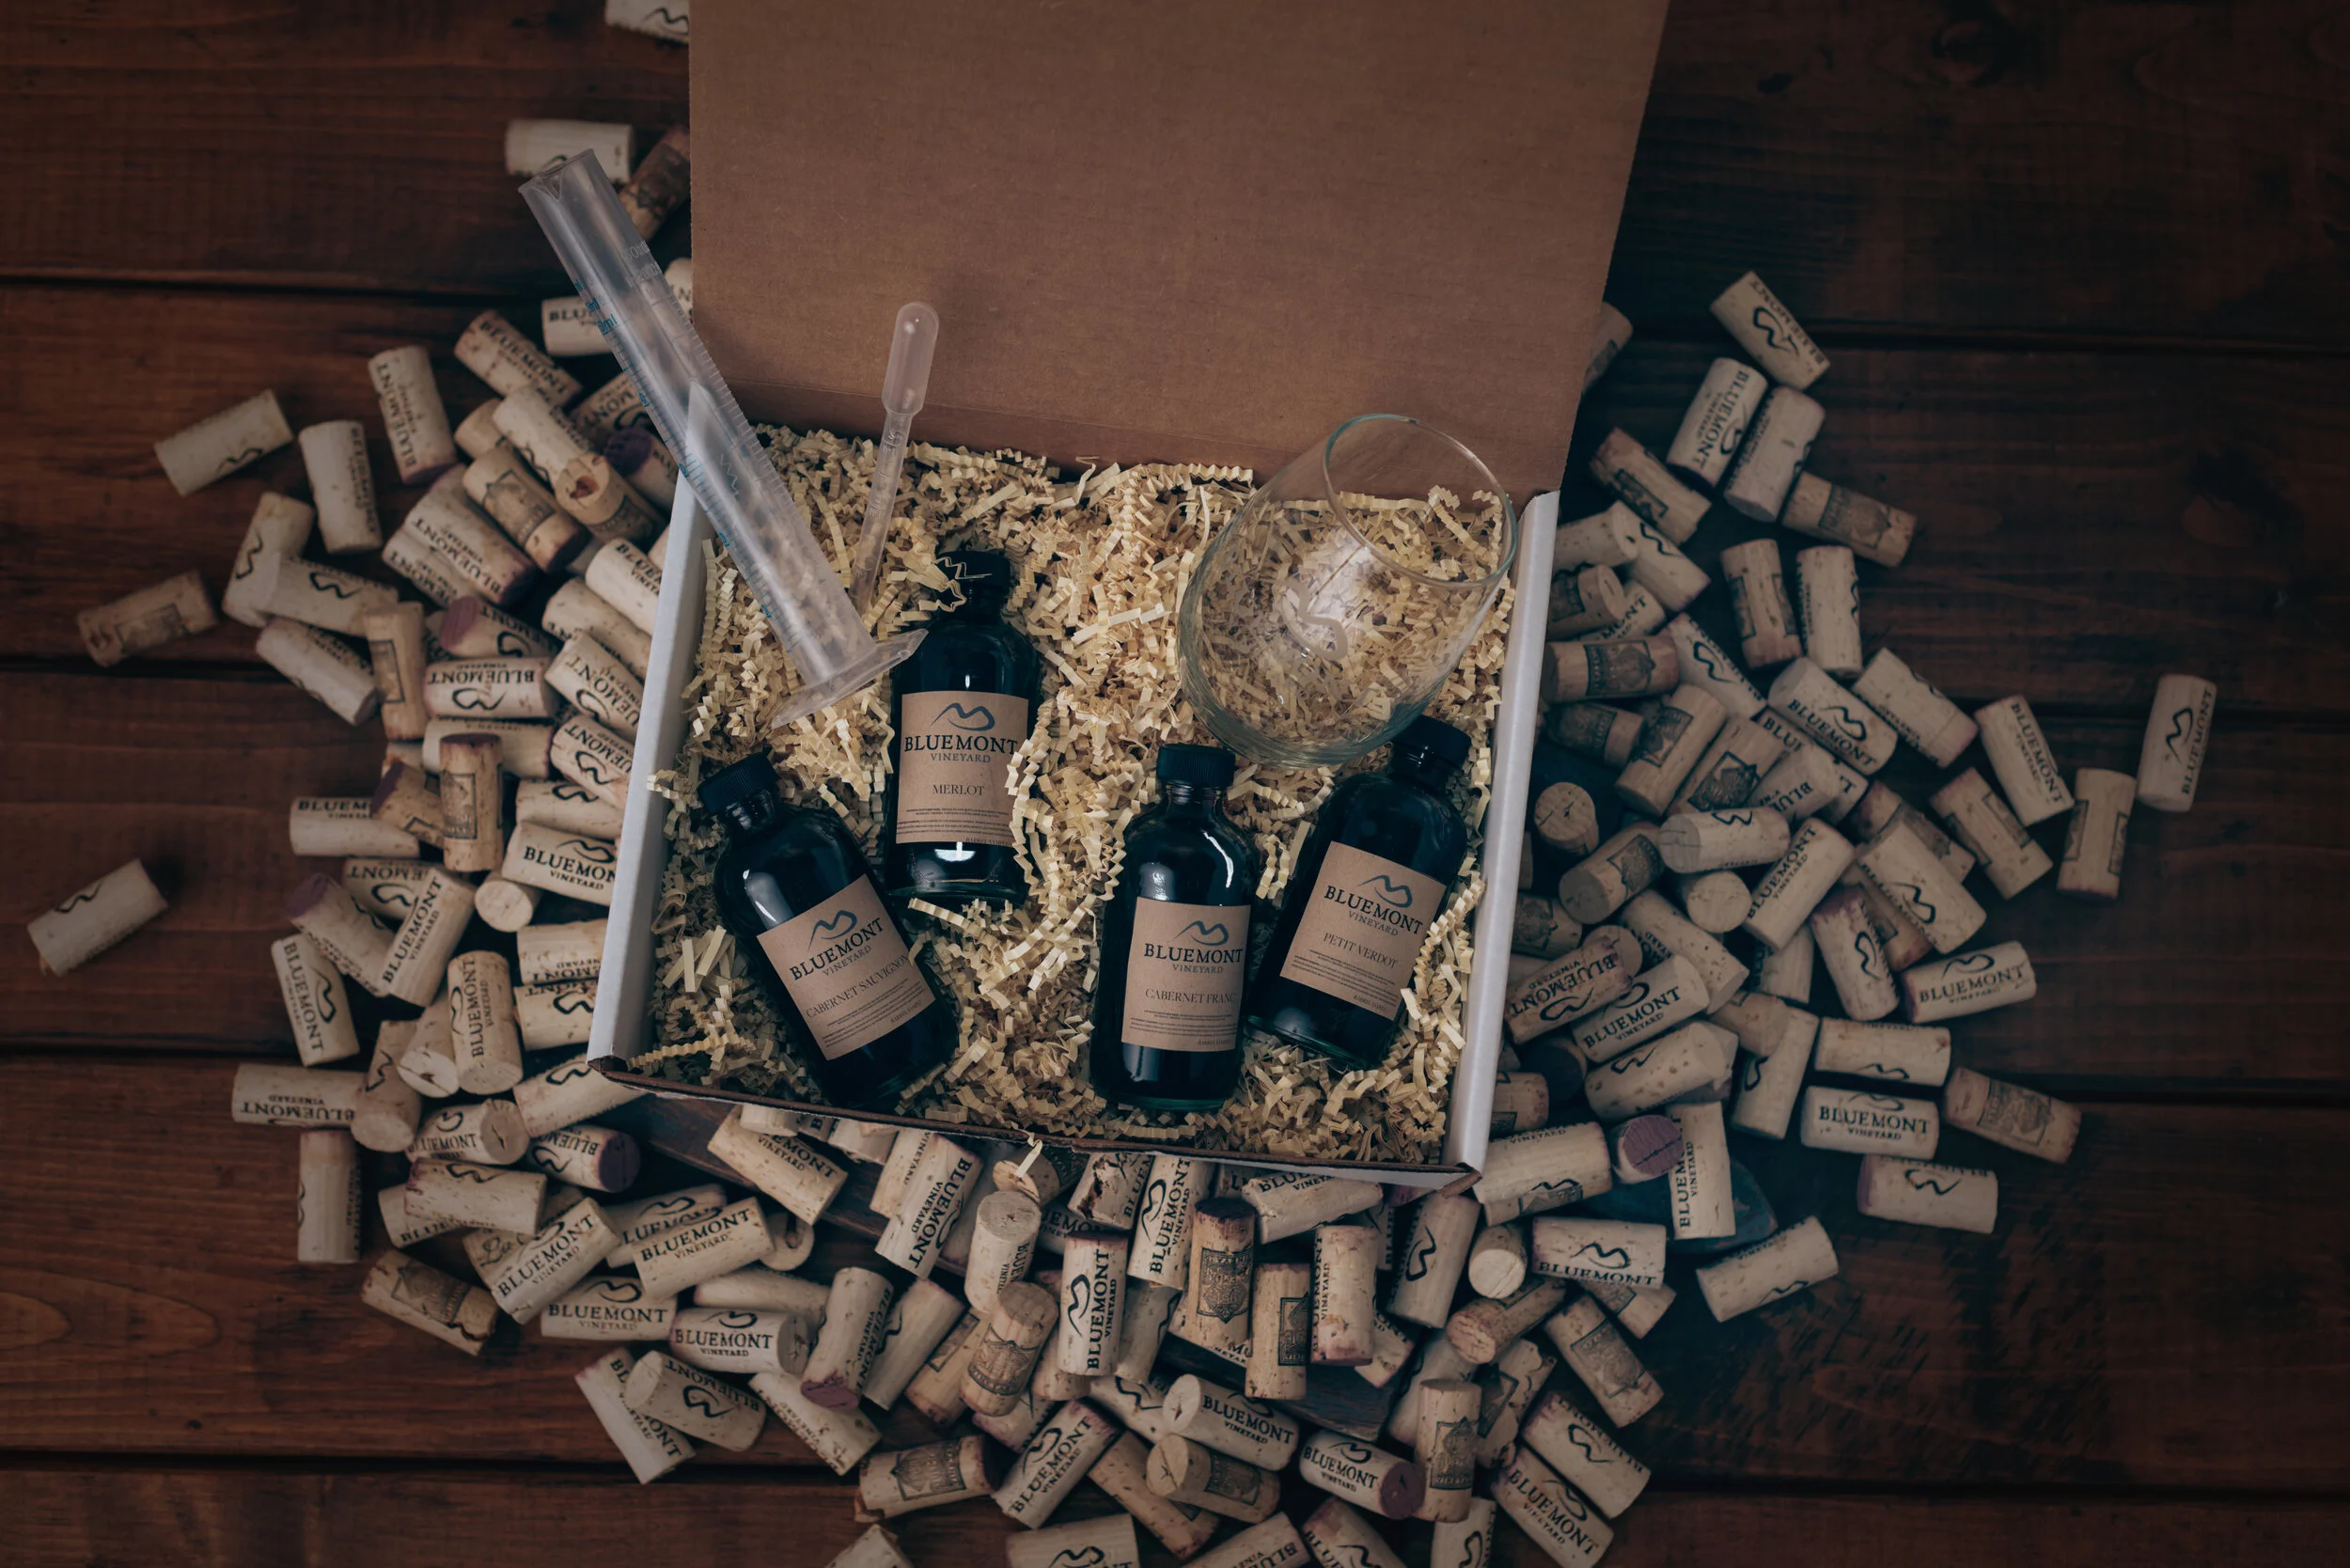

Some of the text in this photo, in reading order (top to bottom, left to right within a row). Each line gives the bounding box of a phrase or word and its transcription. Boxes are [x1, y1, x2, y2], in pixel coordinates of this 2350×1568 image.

[414, 518, 502, 595] BLUEMONT
[427, 670, 535, 685] BLUEMONT
[566, 654, 641, 729] UEMONT
[565, 725, 633, 774] UEMONT
[904, 734, 1018, 756] BLUEMONT
[1787, 699, 1877, 767] BLUEMONT
[2011, 702, 2062, 805] BLUEMONT
[931, 752, 991, 763] VINEYARD
[298, 799, 372, 812] BLUEM
[932, 784, 985, 796] MERLOT
[523, 851, 616, 886] BLUEMON
[550, 870, 603, 891] VINEYARD
[1747, 823, 1817, 920] BLUEMONT
[382, 876, 445, 985] BLUEMONT
[1324, 885, 1423, 935] BLUEMONT
[1348, 910, 1399, 937] VINEYARD
[790, 917, 885, 981] BLUEMONT
[822, 944, 872, 978] VINEYARD
[1144, 943, 1244, 964] BLUEMONT
[1172, 964, 1224, 974] VINEYARD
[1324, 932, 1400, 968] PETIT VERDOT
[283, 940, 324, 1051] BLUEMONT
[462, 955, 487, 1058] BLUEMONT
[806, 981, 859, 1019] CABERNET
[1145, 988, 1206, 1004] CABERNET
[1508, 954, 1618, 1018] BLUEMONT
[1919, 964, 2026, 1004] BLUEMONT
[1582, 985, 1682, 1049] BLUEMONT
[240, 1101, 355, 1121] BLUEMONT
[1819, 1105, 1931, 1135] BLUEMONT
[768, 1131, 838, 1179] EMONT
[911, 1180, 944, 1234] VINEYARD
[1123, 1155, 1153, 1218] BLUEM
[641, 1208, 751, 1262] BLUEMONT
[908, 1156, 972, 1269] BLUEMONT
[1149, 1156, 1191, 1275] BLUEMONT
[498, 1214, 595, 1298] BLUEMONT
[1539, 1262, 1657, 1286] BLUEMONT
[548, 1303, 669, 1325] BLUEMONT
[1087, 1249, 1110, 1370] BLUEMONT
[1104, 1278, 1118, 1338] VINEYARD
[675, 1327, 775, 1351] BLUEMONT
[699, 1346, 750, 1357] VINEYARD
[665, 1358, 761, 1414] BLUEMONT
[1203, 1394, 1294, 1446] BLUEMONT
[1224, 1420, 1269, 1446] VINEYARD
[1010, 1416, 1092, 1514] BLUEMONT
[1303, 1446, 1379, 1490] BLUEMONT
